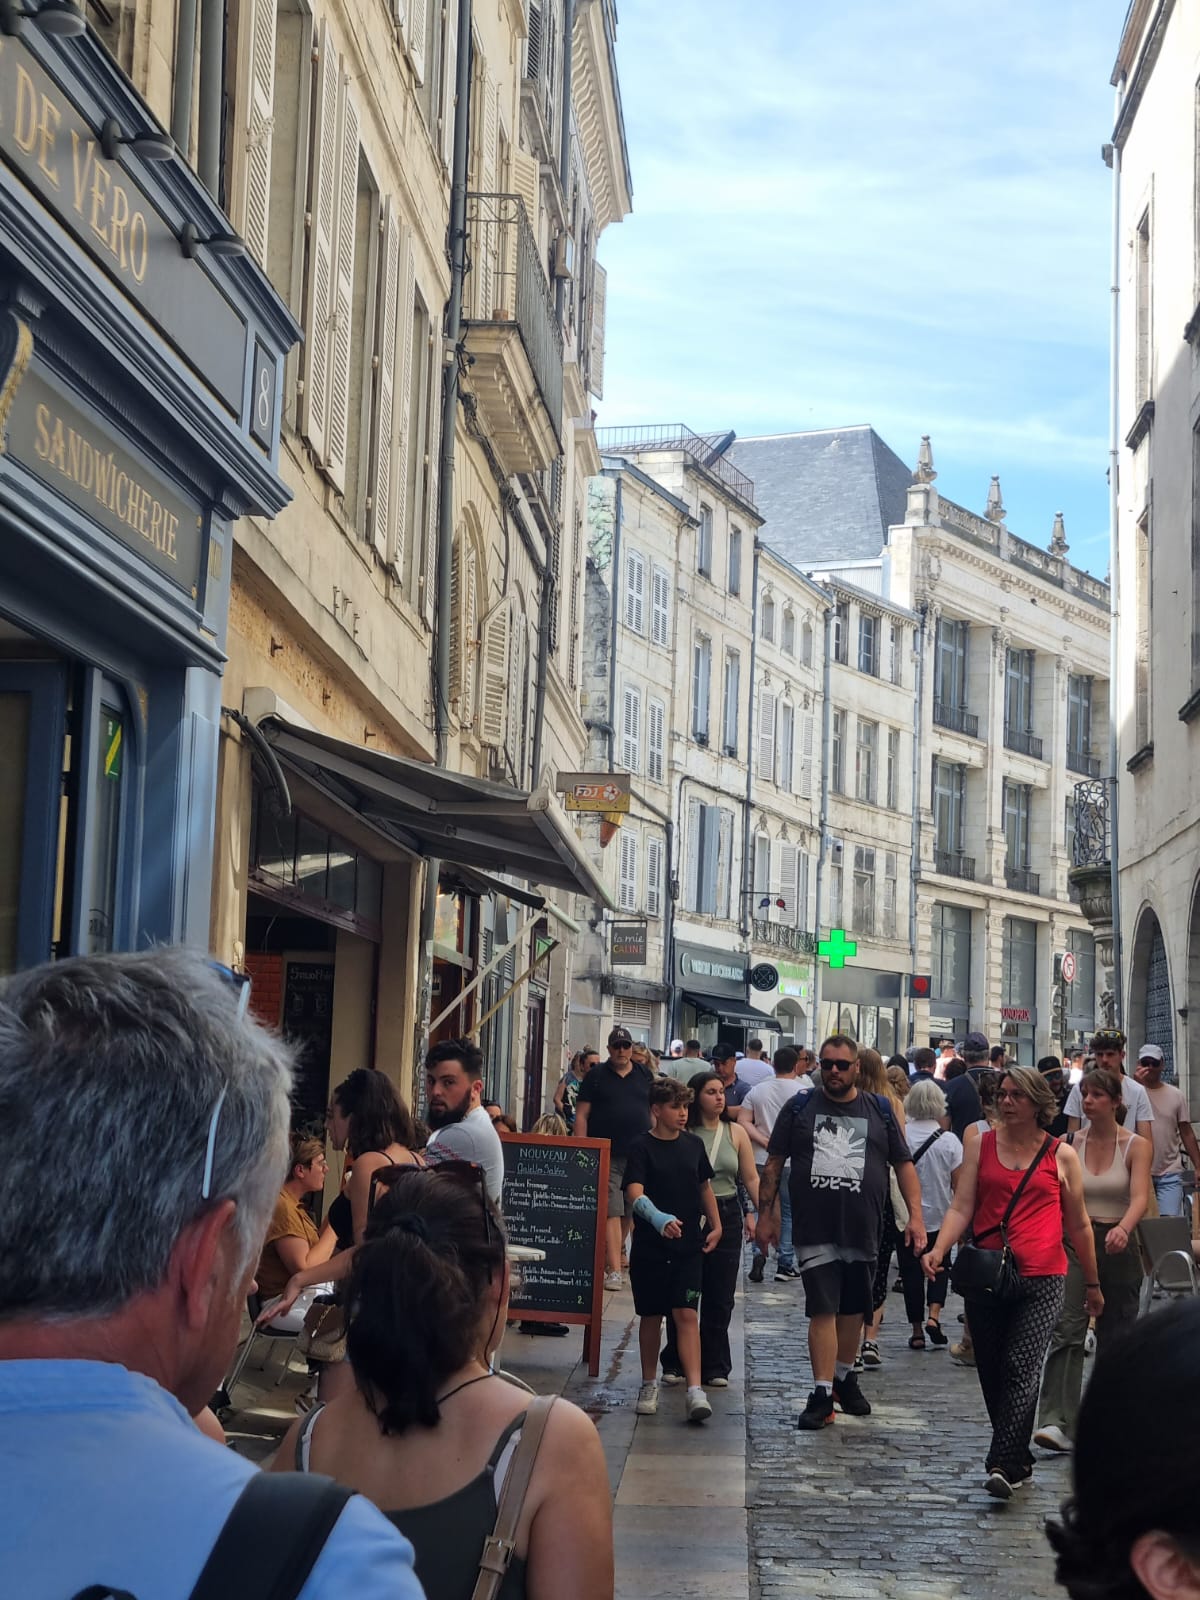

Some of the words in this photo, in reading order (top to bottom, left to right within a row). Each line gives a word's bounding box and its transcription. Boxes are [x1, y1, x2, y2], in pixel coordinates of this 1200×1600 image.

[12, 62, 62, 192] DE
[70, 129, 148, 284] VERO
[257, 367, 269, 431] 8
[34, 402, 179, 562] SANDWICHERIE
[575, 786, 599, 798] FDJ
[519, 1148, 567, 1160] NOUVEAU
[810, 1175, 862, 1193] ワンピース
